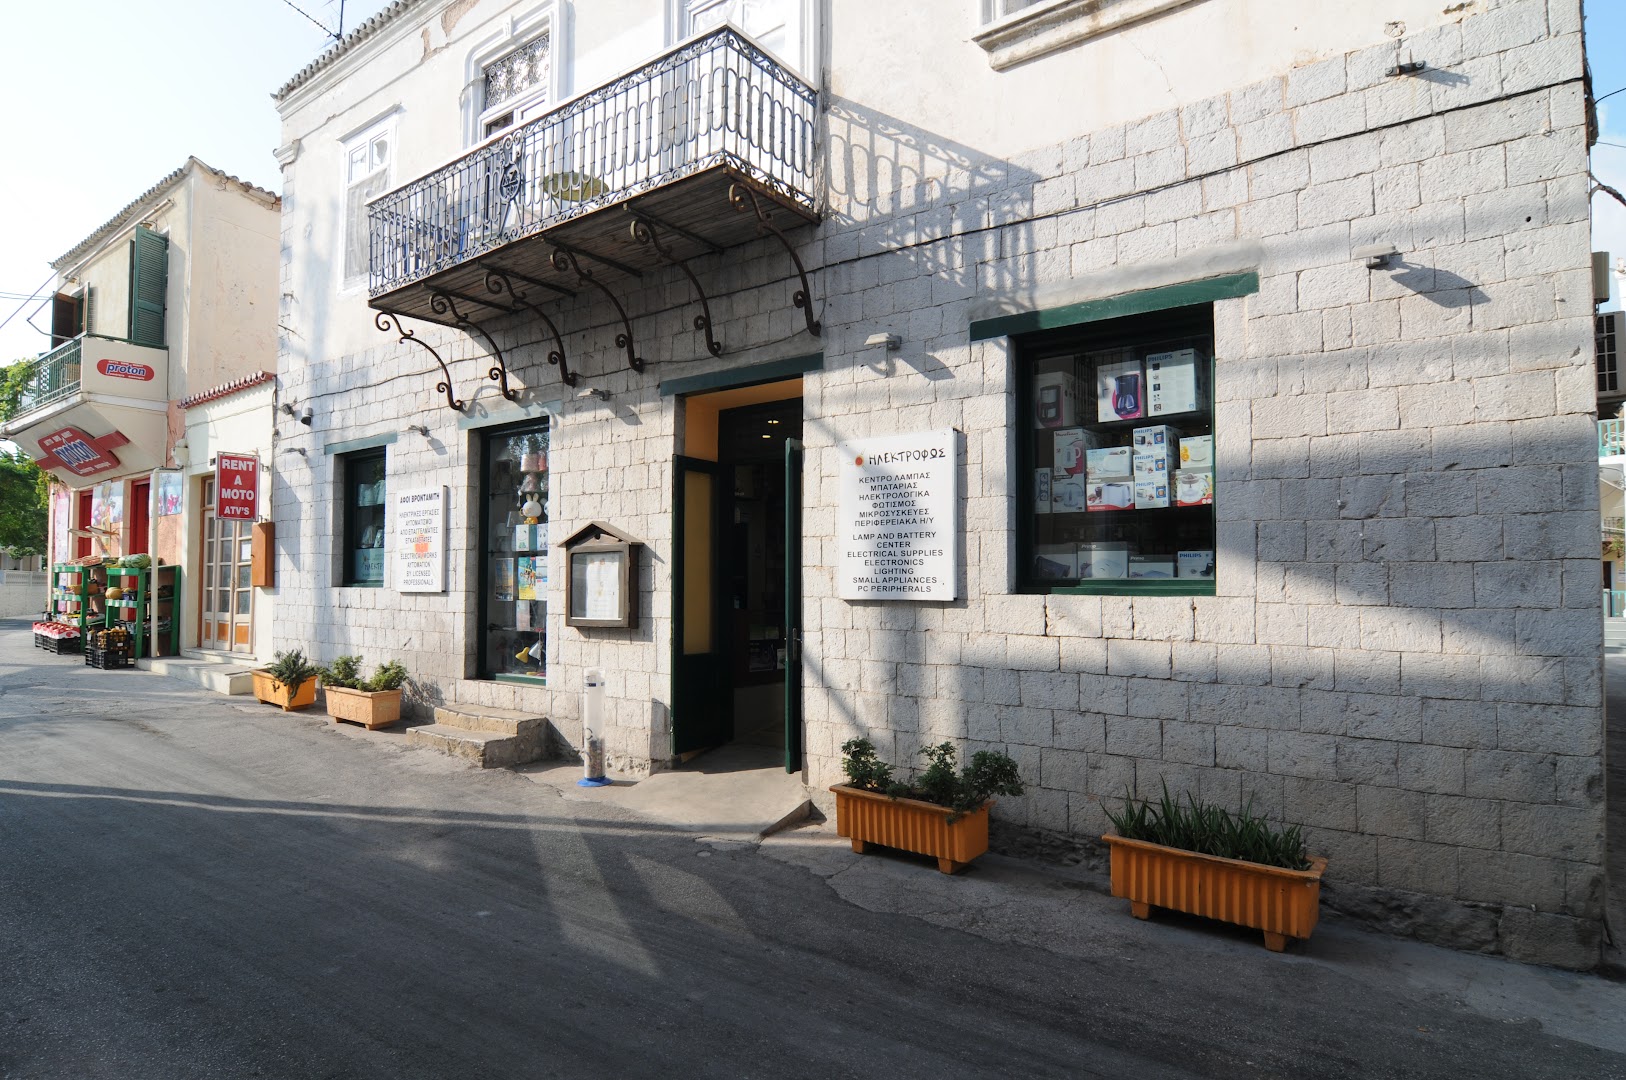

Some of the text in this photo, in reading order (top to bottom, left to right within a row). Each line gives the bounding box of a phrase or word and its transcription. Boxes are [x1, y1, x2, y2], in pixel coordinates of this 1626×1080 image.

[1148, 354, 1172, 362] PHILIPS
[106, 364, 146, 376] proton
[869, 448, 946, 466] ΗΛΕΚΤΡΟΦΩΣ
[222, 459, 254, 471] RENT
[234, 475, 242, 486] A
[859, 472, 930, 484] ΚΕΝΤΡΟ ΛΑΜΠΑΣ
[870, 482, 918, 491] ΜΠΑΤΑΡΙΑΣ
[221, 488, 254, 500] MOTO
[859, 491, 930, 500] ΗΛΕΚΤΡΟΛΟΓΙΚΑ
[872, 500, 916, 508] ΦΩΤΙΣΜΟΣ
[224, 506, 250, 515] ATV'S
[859, 508, 930, 518] ΜΙΚΡΟΣΥΣΚΕΥΕΣ
[855, 518, 917, 527] ΠΕΡΙΦΕΡΕΙΑΚΑ
